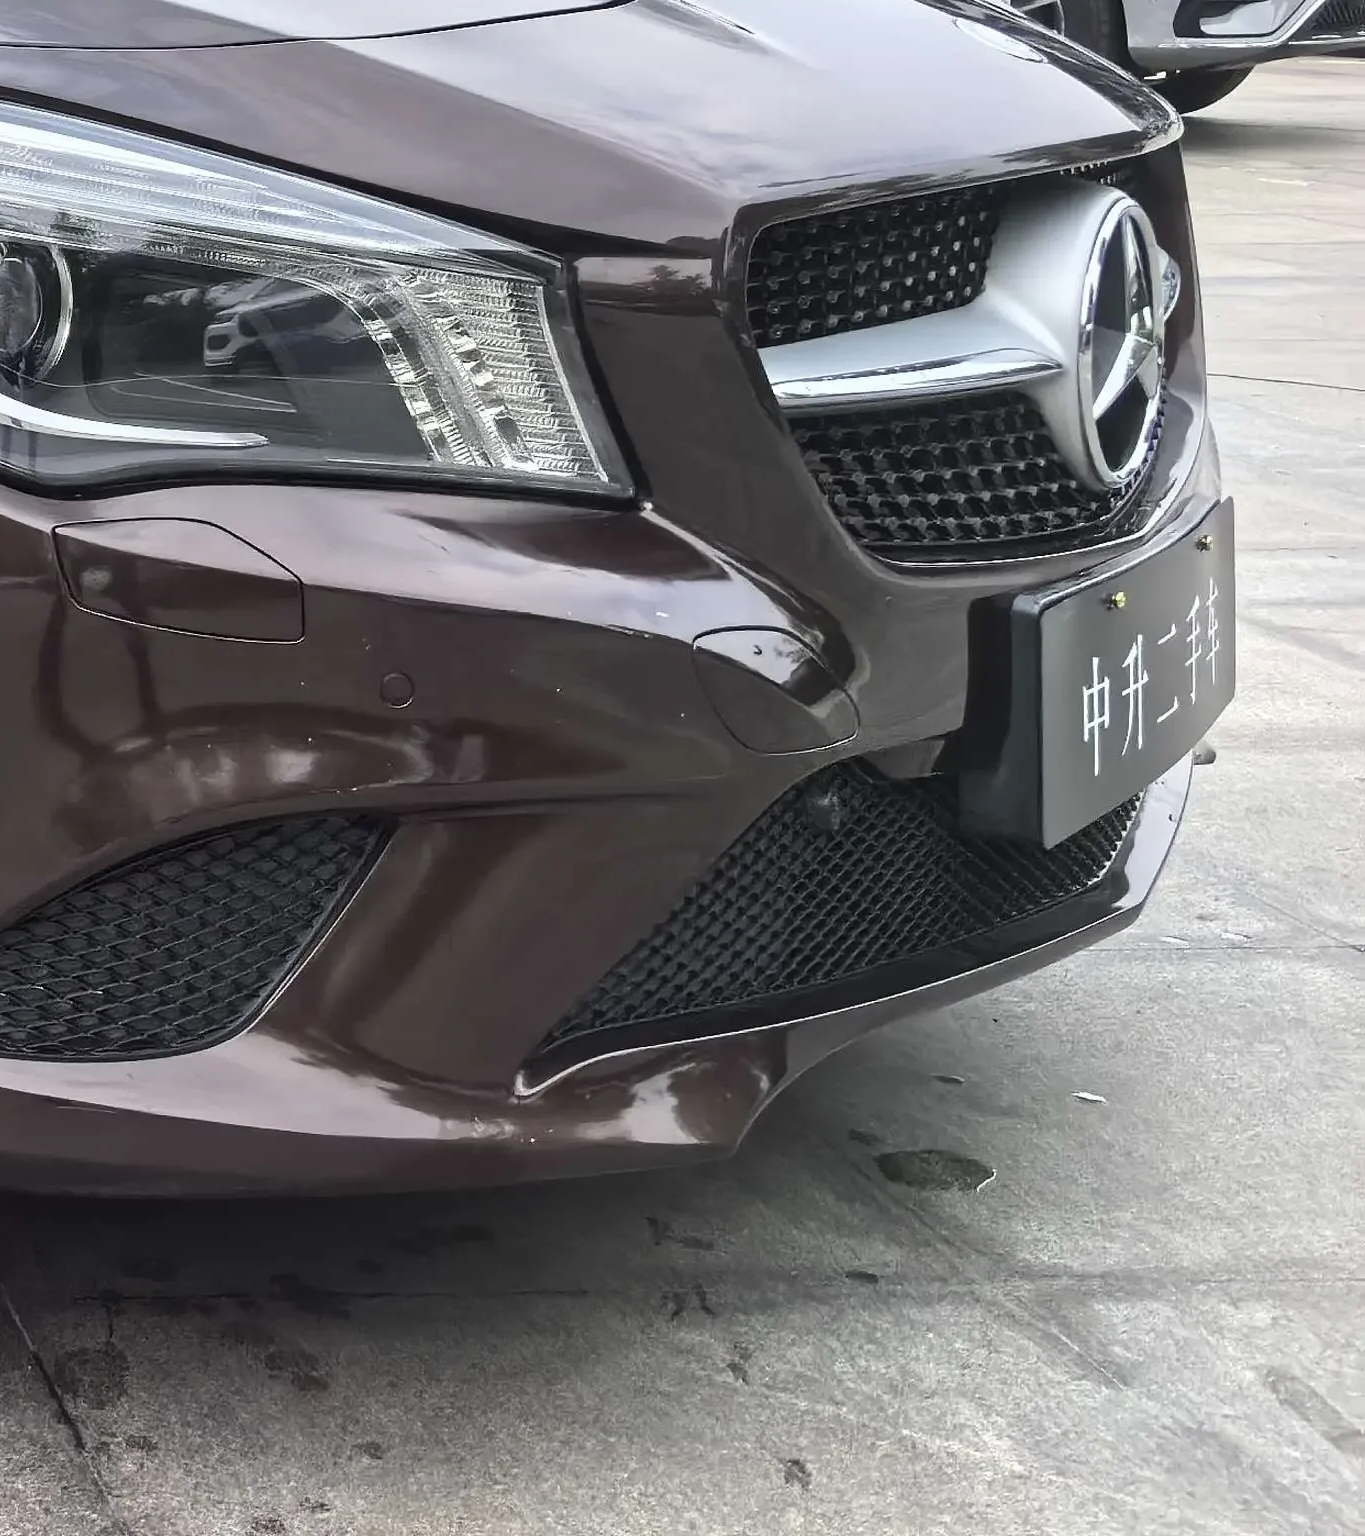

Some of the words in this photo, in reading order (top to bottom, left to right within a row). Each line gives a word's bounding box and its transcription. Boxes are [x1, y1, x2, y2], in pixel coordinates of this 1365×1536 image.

[1082, 576, 1221, 777] 中升二手车
